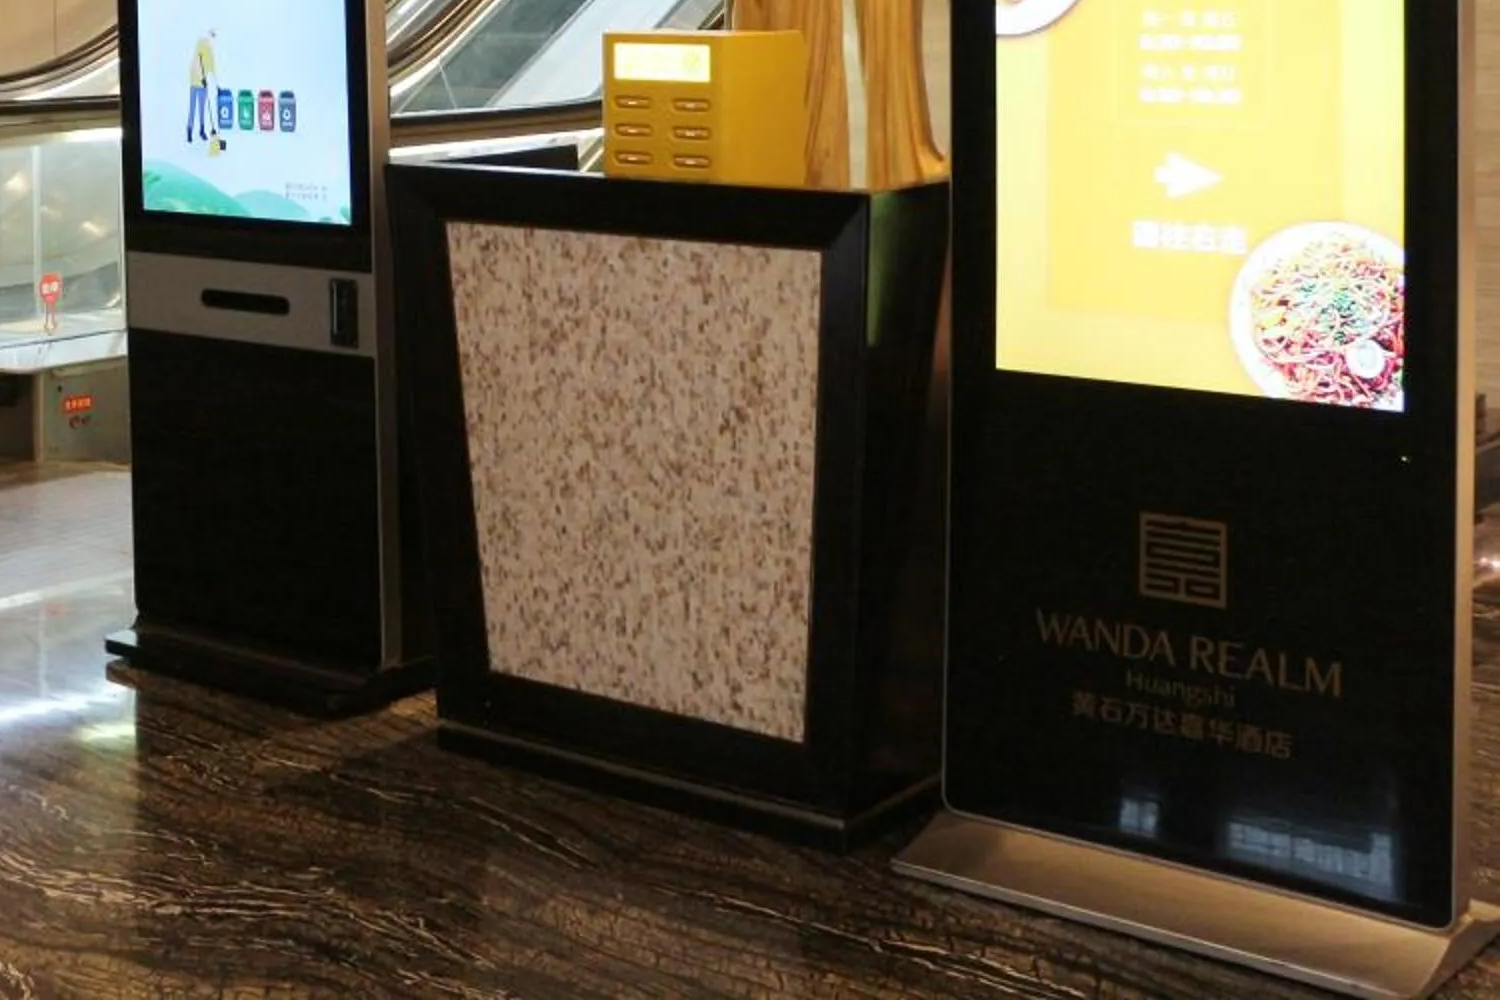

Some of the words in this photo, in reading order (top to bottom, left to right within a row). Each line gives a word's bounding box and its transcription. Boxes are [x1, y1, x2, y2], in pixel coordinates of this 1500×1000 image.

[1035, 607, 1176, 667] WANDA
[1189, 636, 1344, 699] REALM
[1126, 669, 1235, 707] Huangshi
[1071, 690, 1295, 760] 黄石万达嘉华酒店
